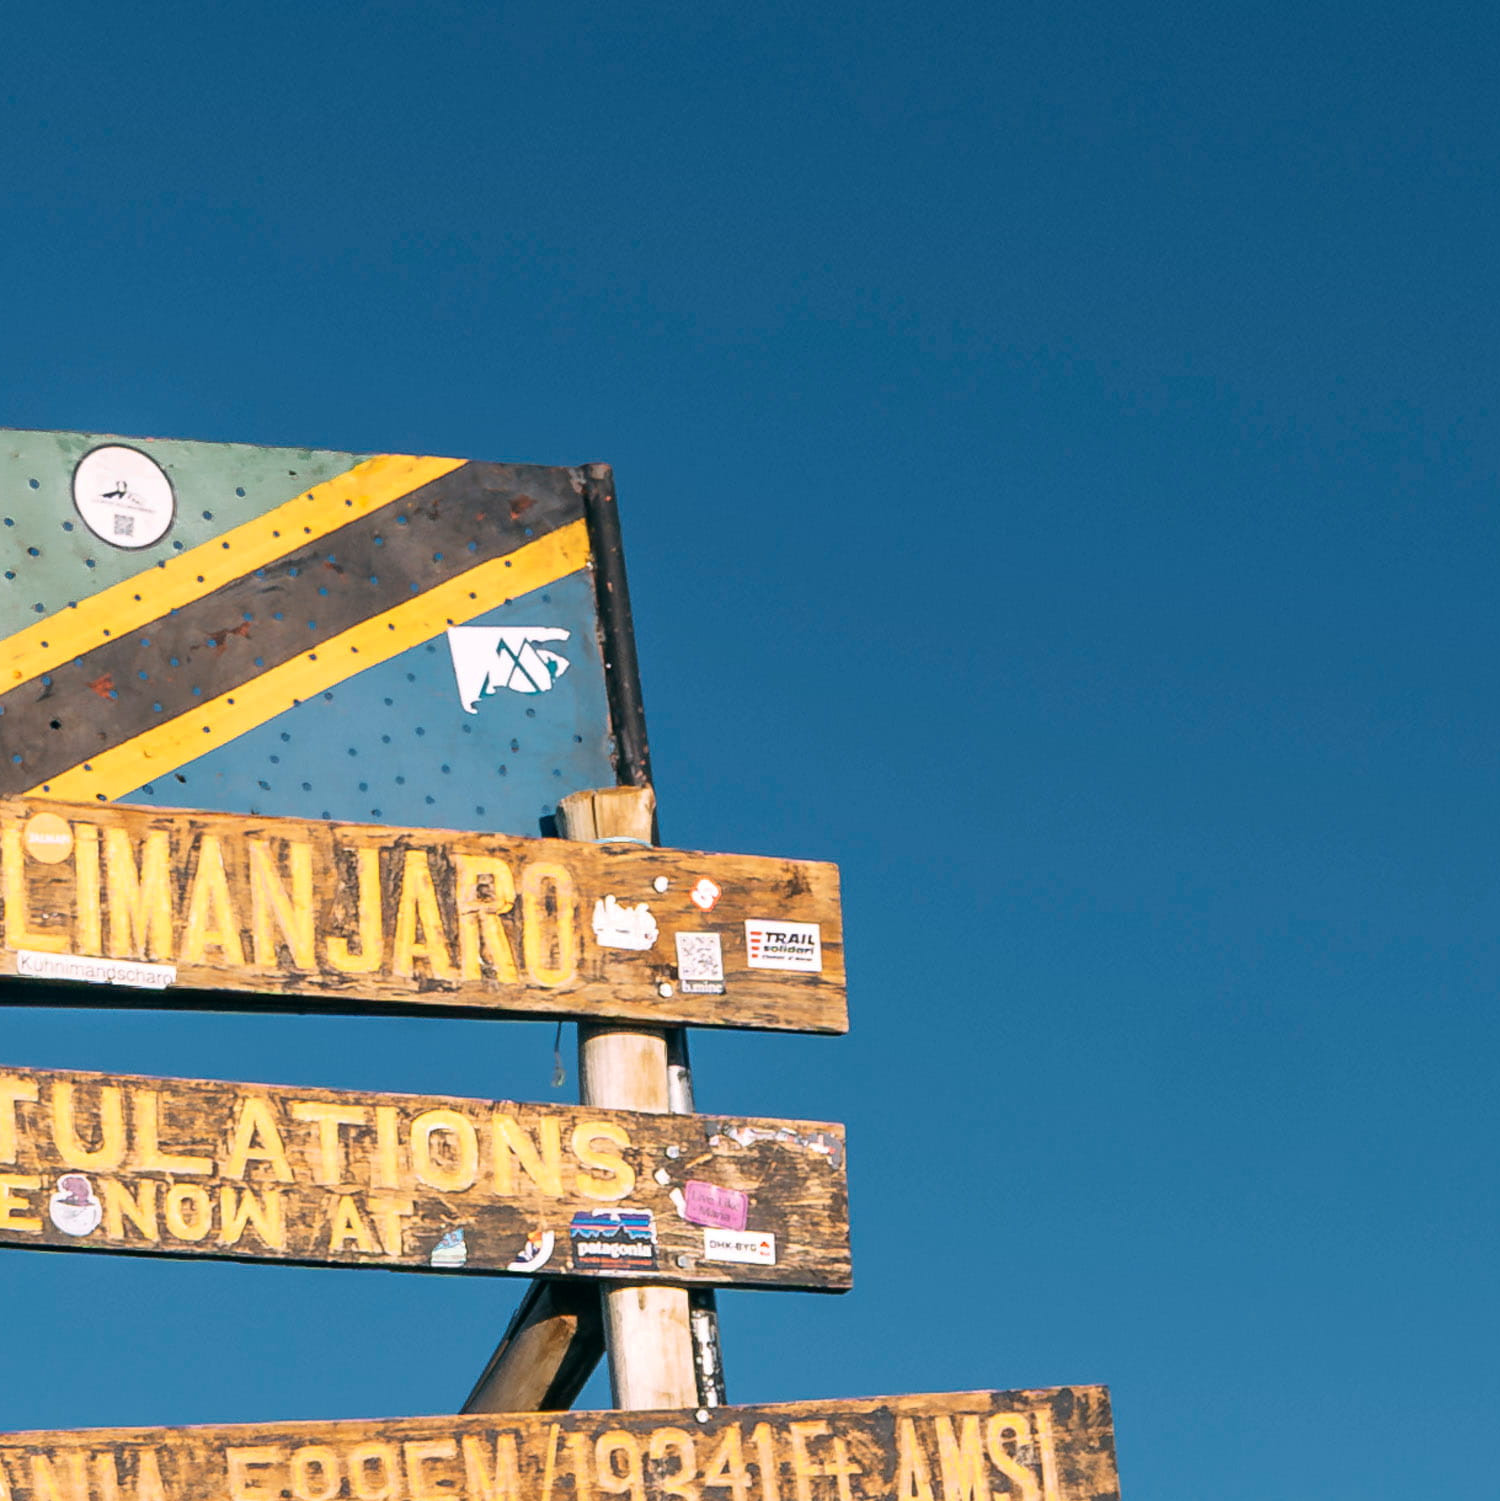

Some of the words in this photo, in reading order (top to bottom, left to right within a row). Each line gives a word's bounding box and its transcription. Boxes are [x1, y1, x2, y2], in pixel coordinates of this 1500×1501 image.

[765, 931, 815, 946] TRAIL
[102, 1177, 287, 1251] NOW
[329, 1195, 415, 1257] AT
[577, 1241, 652, 1259] patagonia
